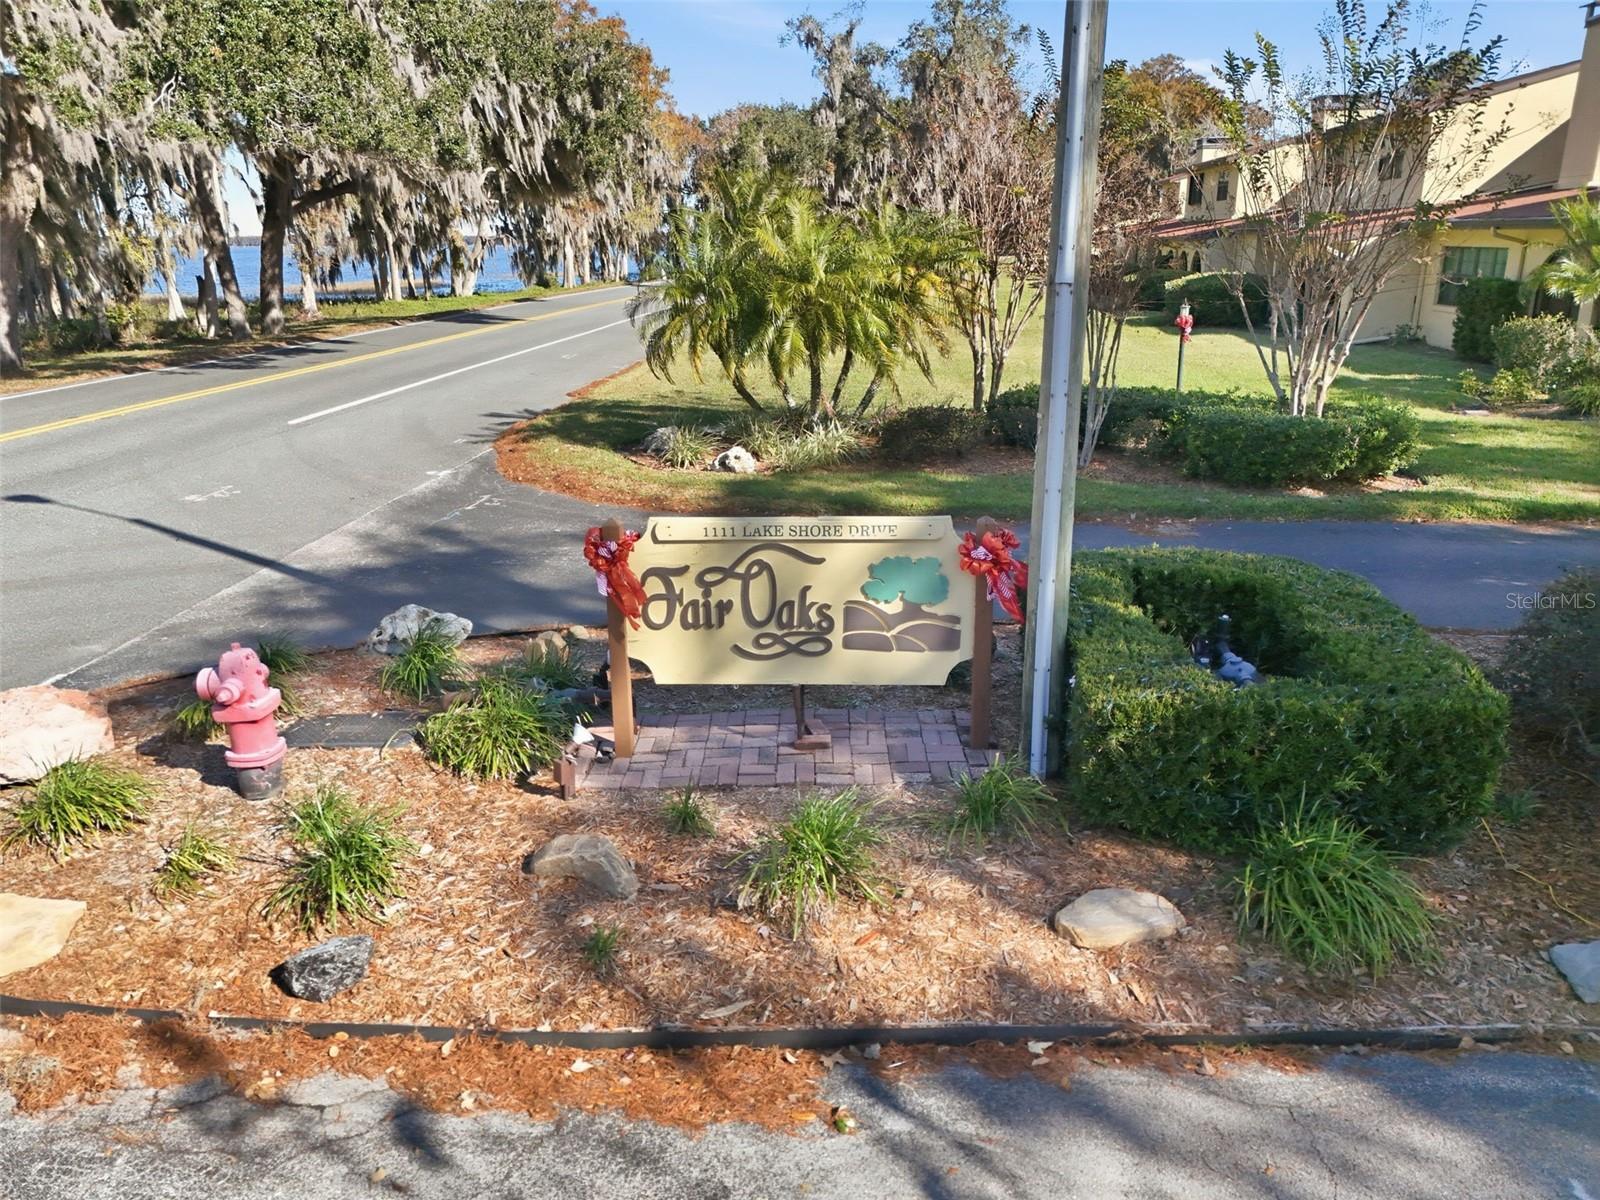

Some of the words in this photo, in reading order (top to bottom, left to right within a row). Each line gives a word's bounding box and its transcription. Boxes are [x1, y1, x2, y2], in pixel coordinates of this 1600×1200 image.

[703, 526, 736, 537] 1111
[743, 525, 784, 537] LAKE
[789, 525, 843, 537] SHORE
[848, 525, 898, 537] DRIVE
[641, 564, 733, 630] Fair
[695, 556, 835, 633] Oaks
